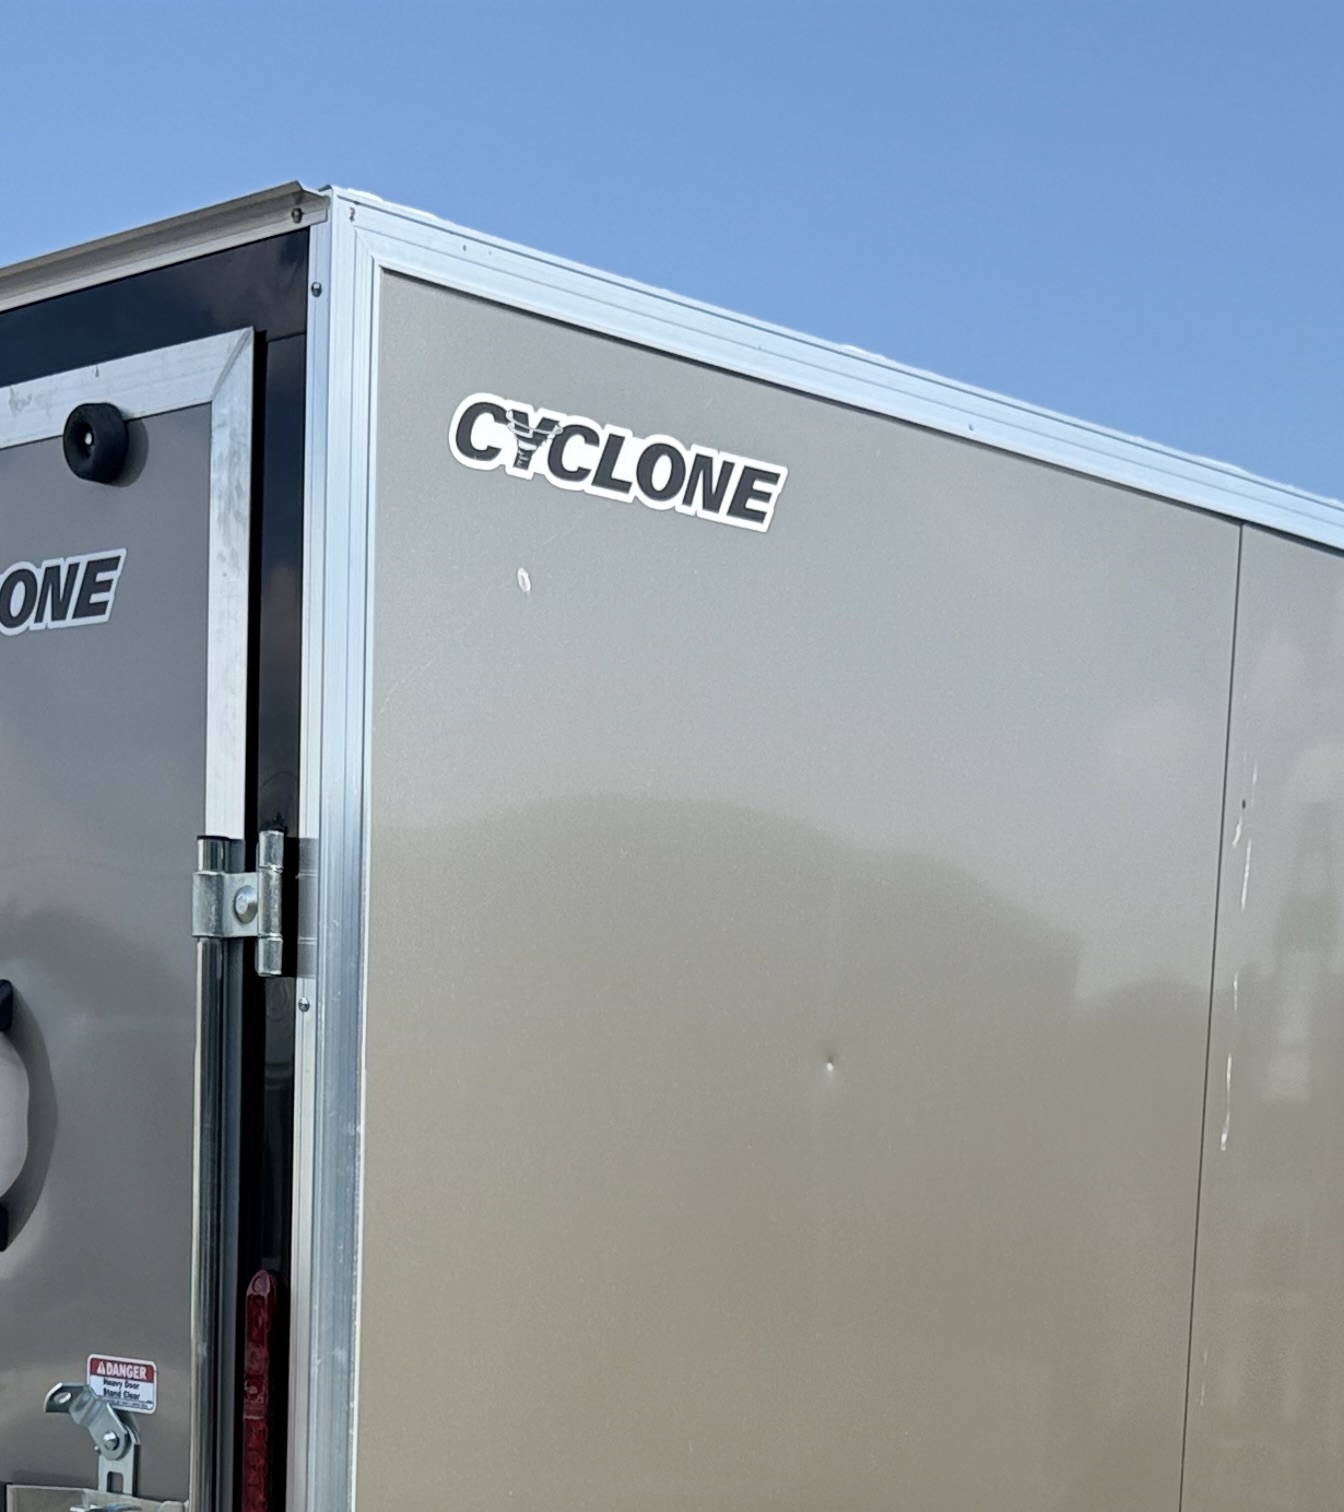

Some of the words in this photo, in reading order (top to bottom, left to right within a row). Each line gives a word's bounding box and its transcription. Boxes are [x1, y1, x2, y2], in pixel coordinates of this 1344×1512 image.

[454, 399, 782, 526] CYCLONE
[106, 1362, 147, 1380] DANGER
[124, 1380, 140, 1390] Door
